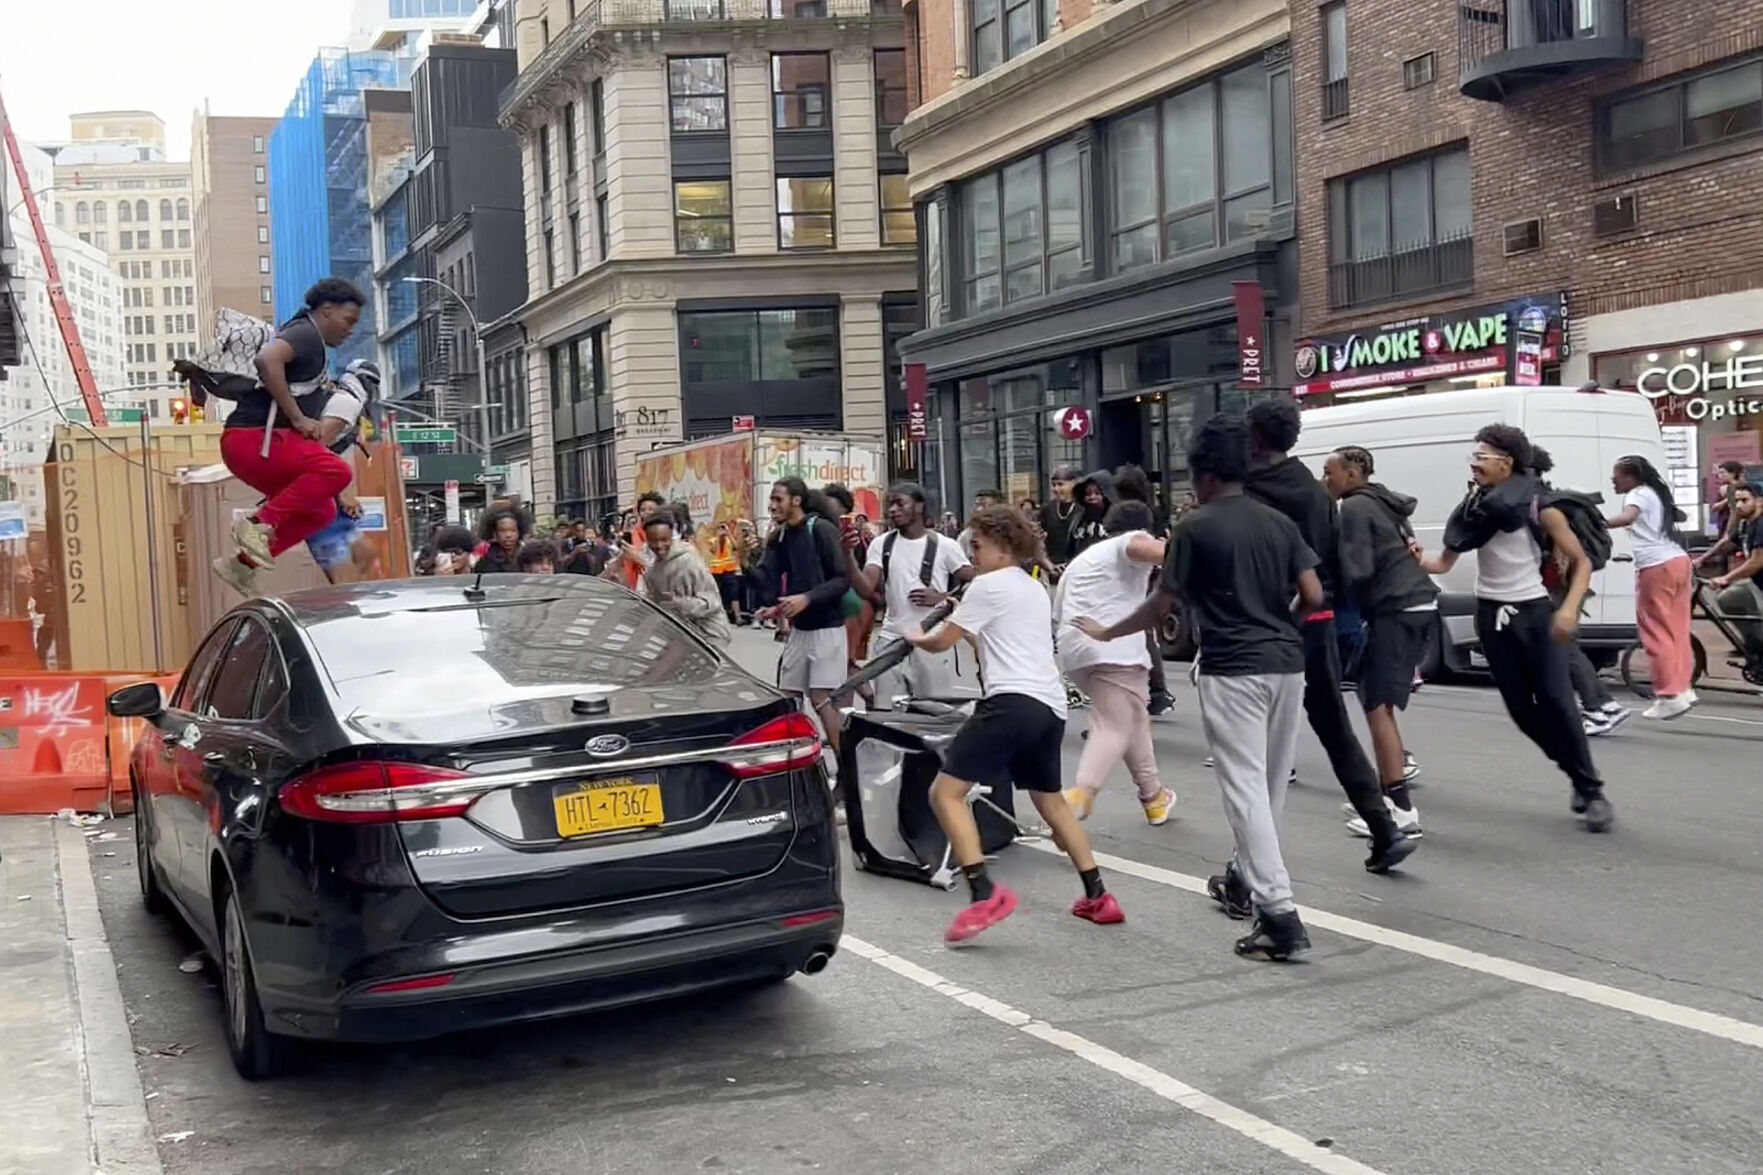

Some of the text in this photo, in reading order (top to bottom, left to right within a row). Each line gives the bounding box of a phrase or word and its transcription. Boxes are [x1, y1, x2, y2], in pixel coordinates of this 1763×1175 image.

[1320, 345, 1328, 372] I
[1427, 331, 1439, 349] &
[1444, 313, 1507, 352] VAPE
[1560, 292, 1569, 356] LOTTO
[1242, 349, 1261, 384] PRET
[637, 406, 668, 425] 817
